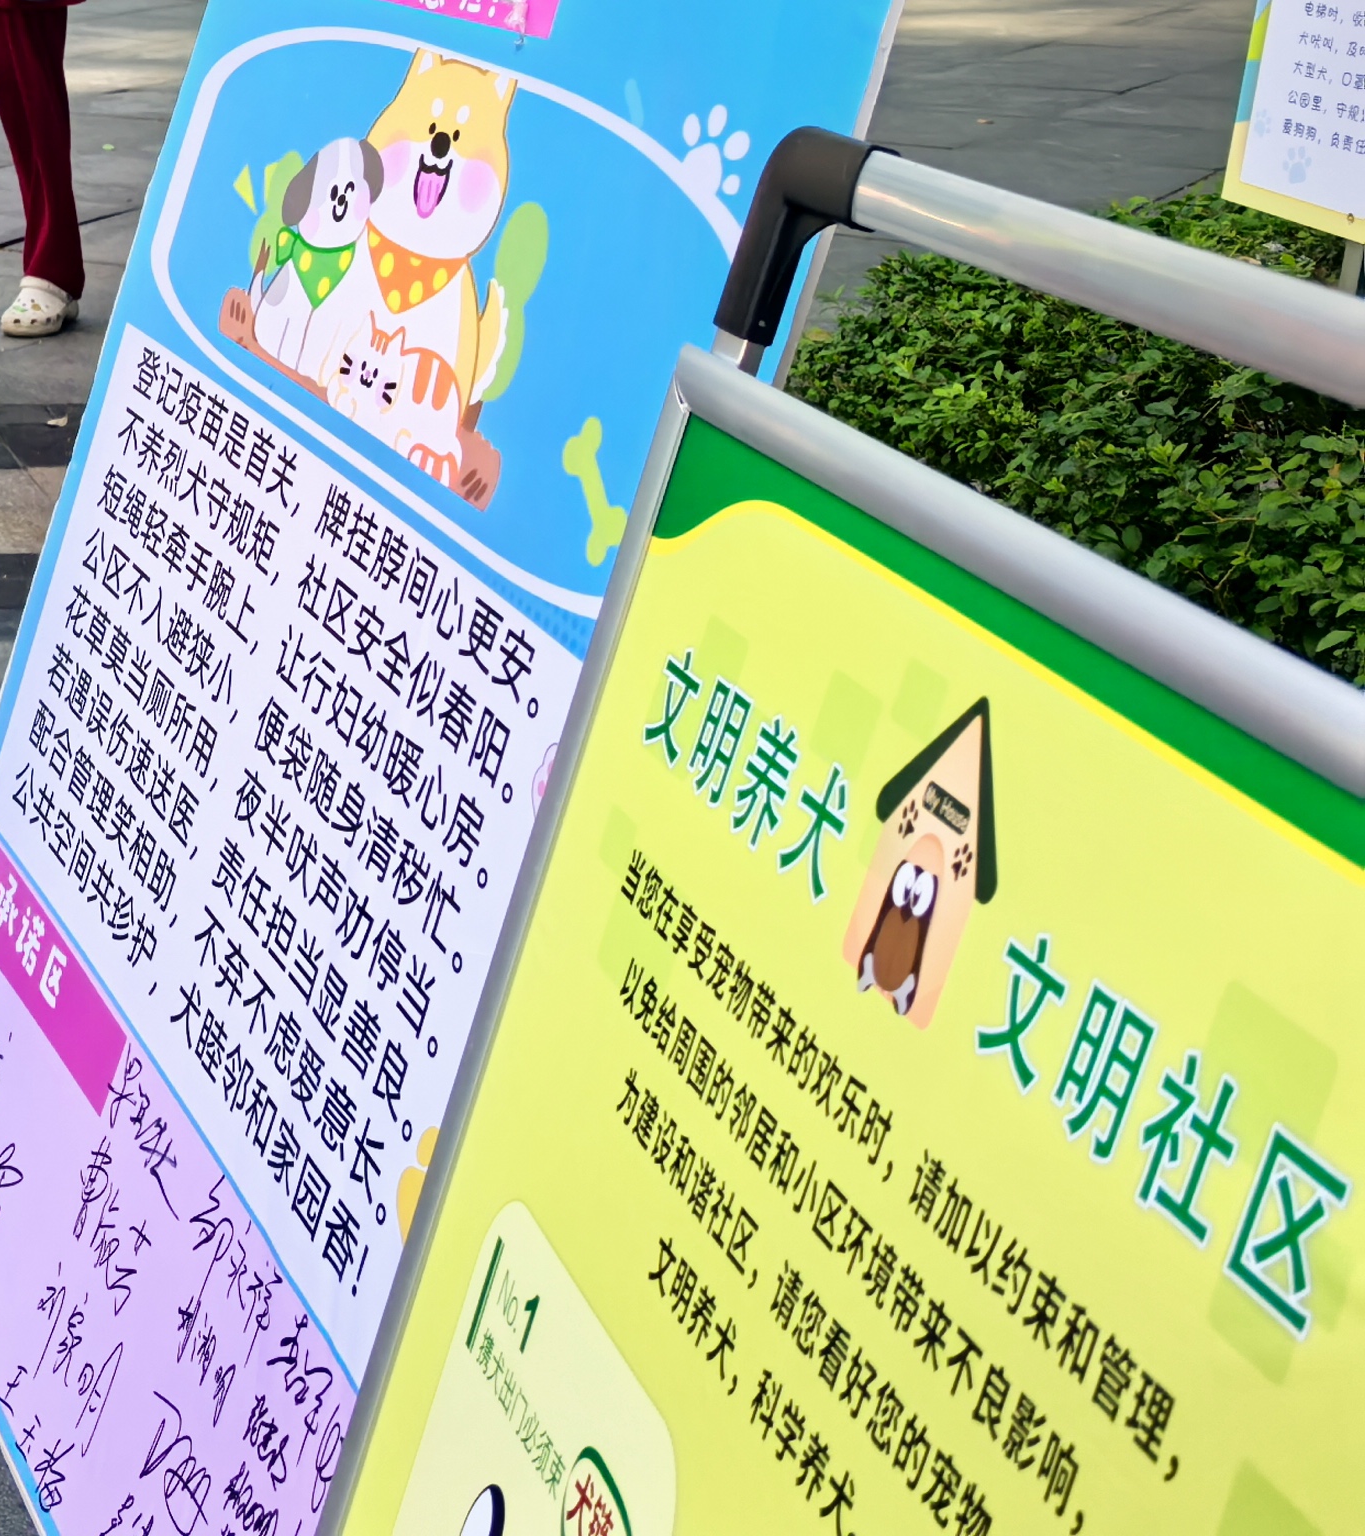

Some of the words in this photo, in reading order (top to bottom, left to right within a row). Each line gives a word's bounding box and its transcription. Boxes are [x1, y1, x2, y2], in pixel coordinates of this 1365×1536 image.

[644, 649, 847, 902] 文明养犬
[975, 932, 1352, 1342] 文明社区
[648, 1237, 857, 1536] 文明养犬，科学养犬
